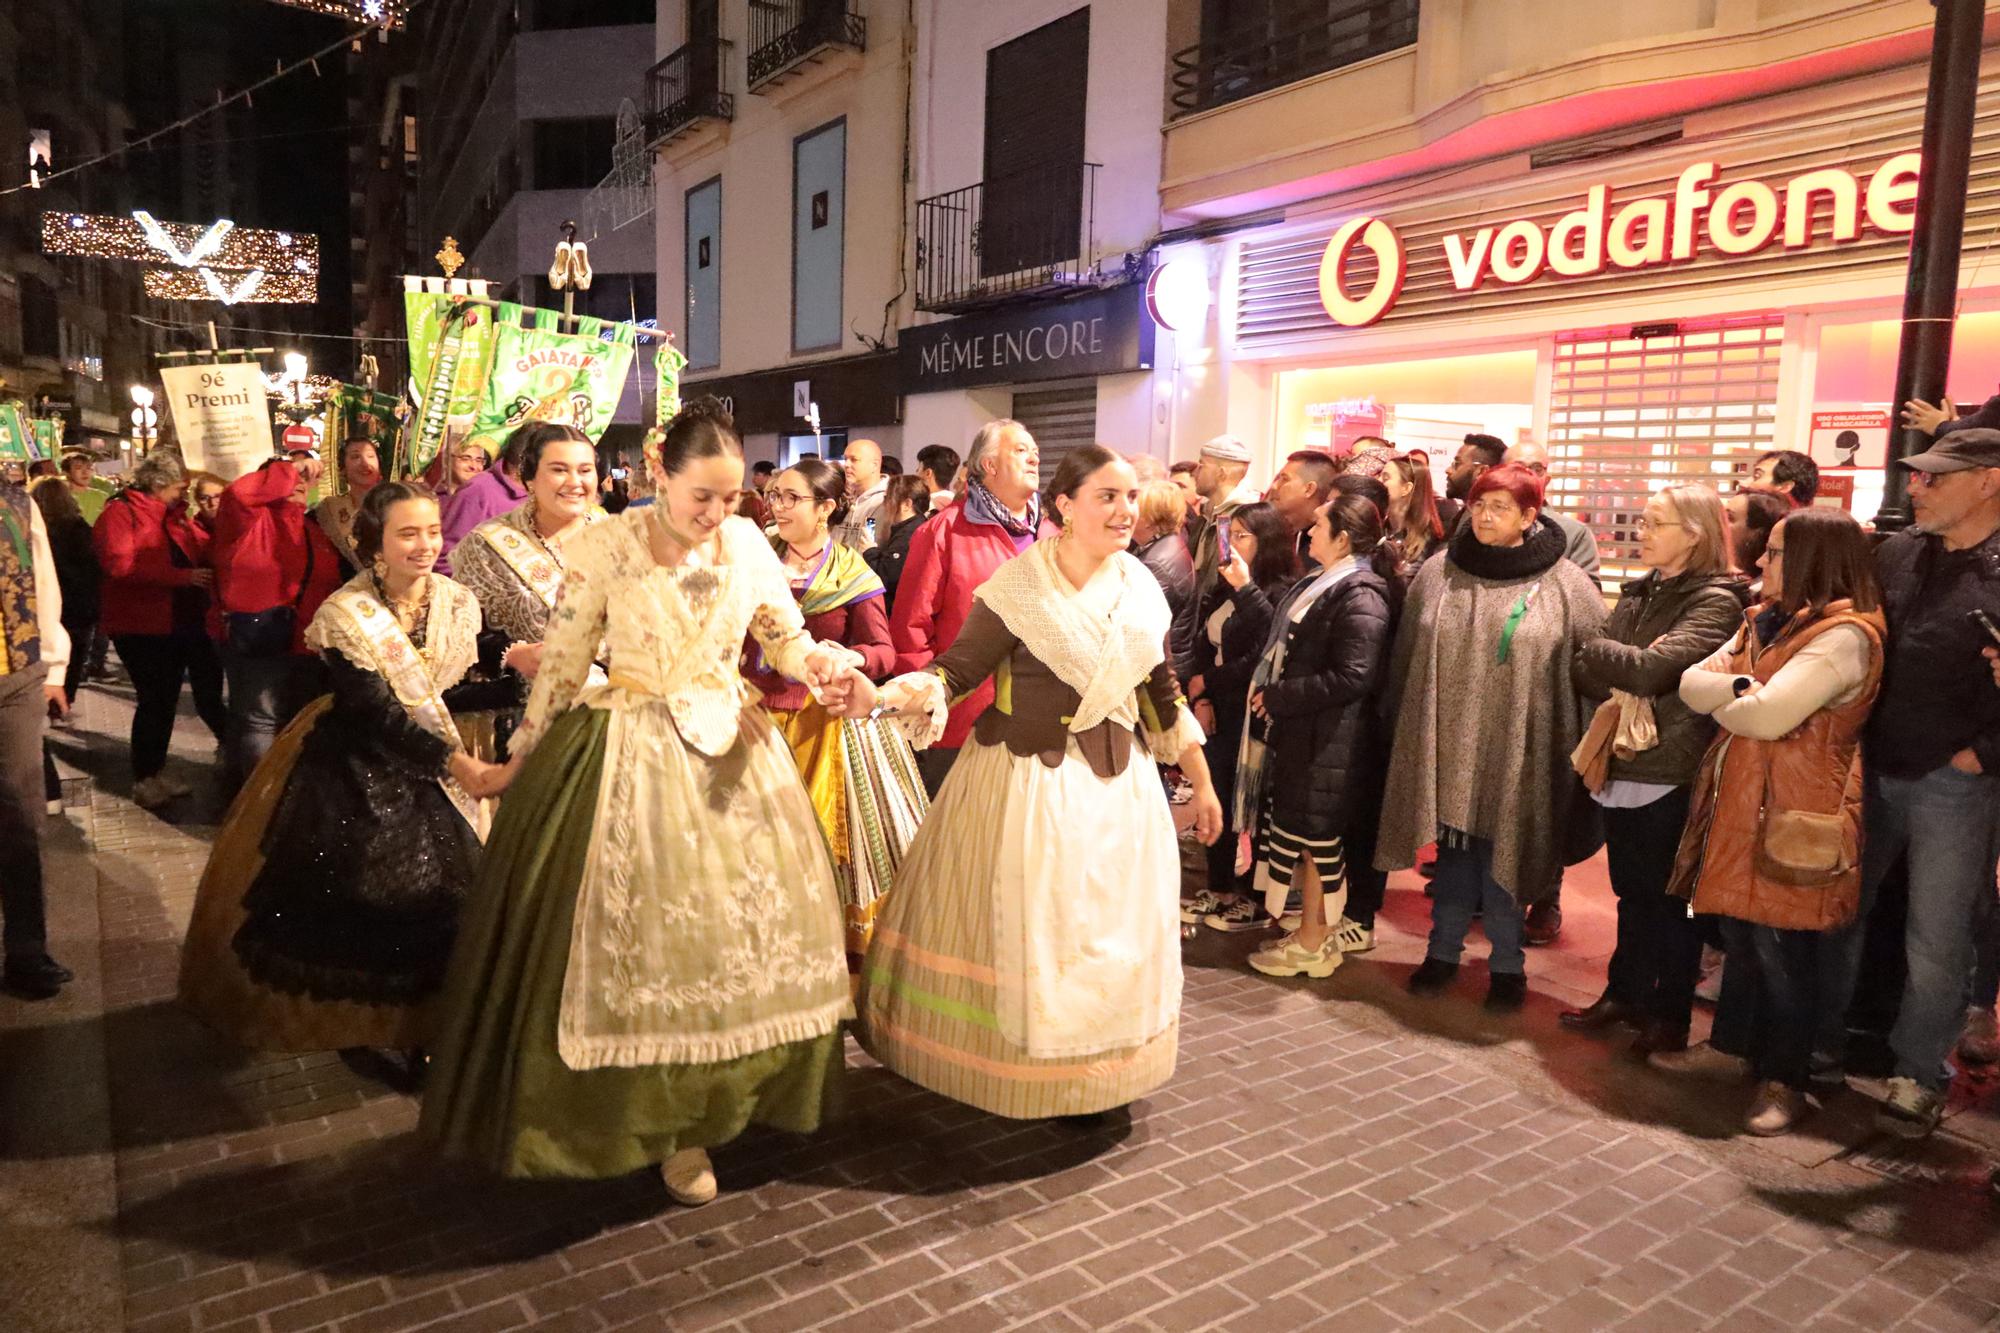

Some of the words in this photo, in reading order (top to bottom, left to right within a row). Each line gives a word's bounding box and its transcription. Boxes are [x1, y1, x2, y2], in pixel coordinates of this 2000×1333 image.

[1441, 152, 1923, 291] vodafone
[920, 332, 985, 376] MÊME
[992, 317, 1104, 367] ENCORE
[516, 349, 578, 373] GAIATA
[200, 371, 225, 388] 9é
[186, 387, 250, 409] Premi
